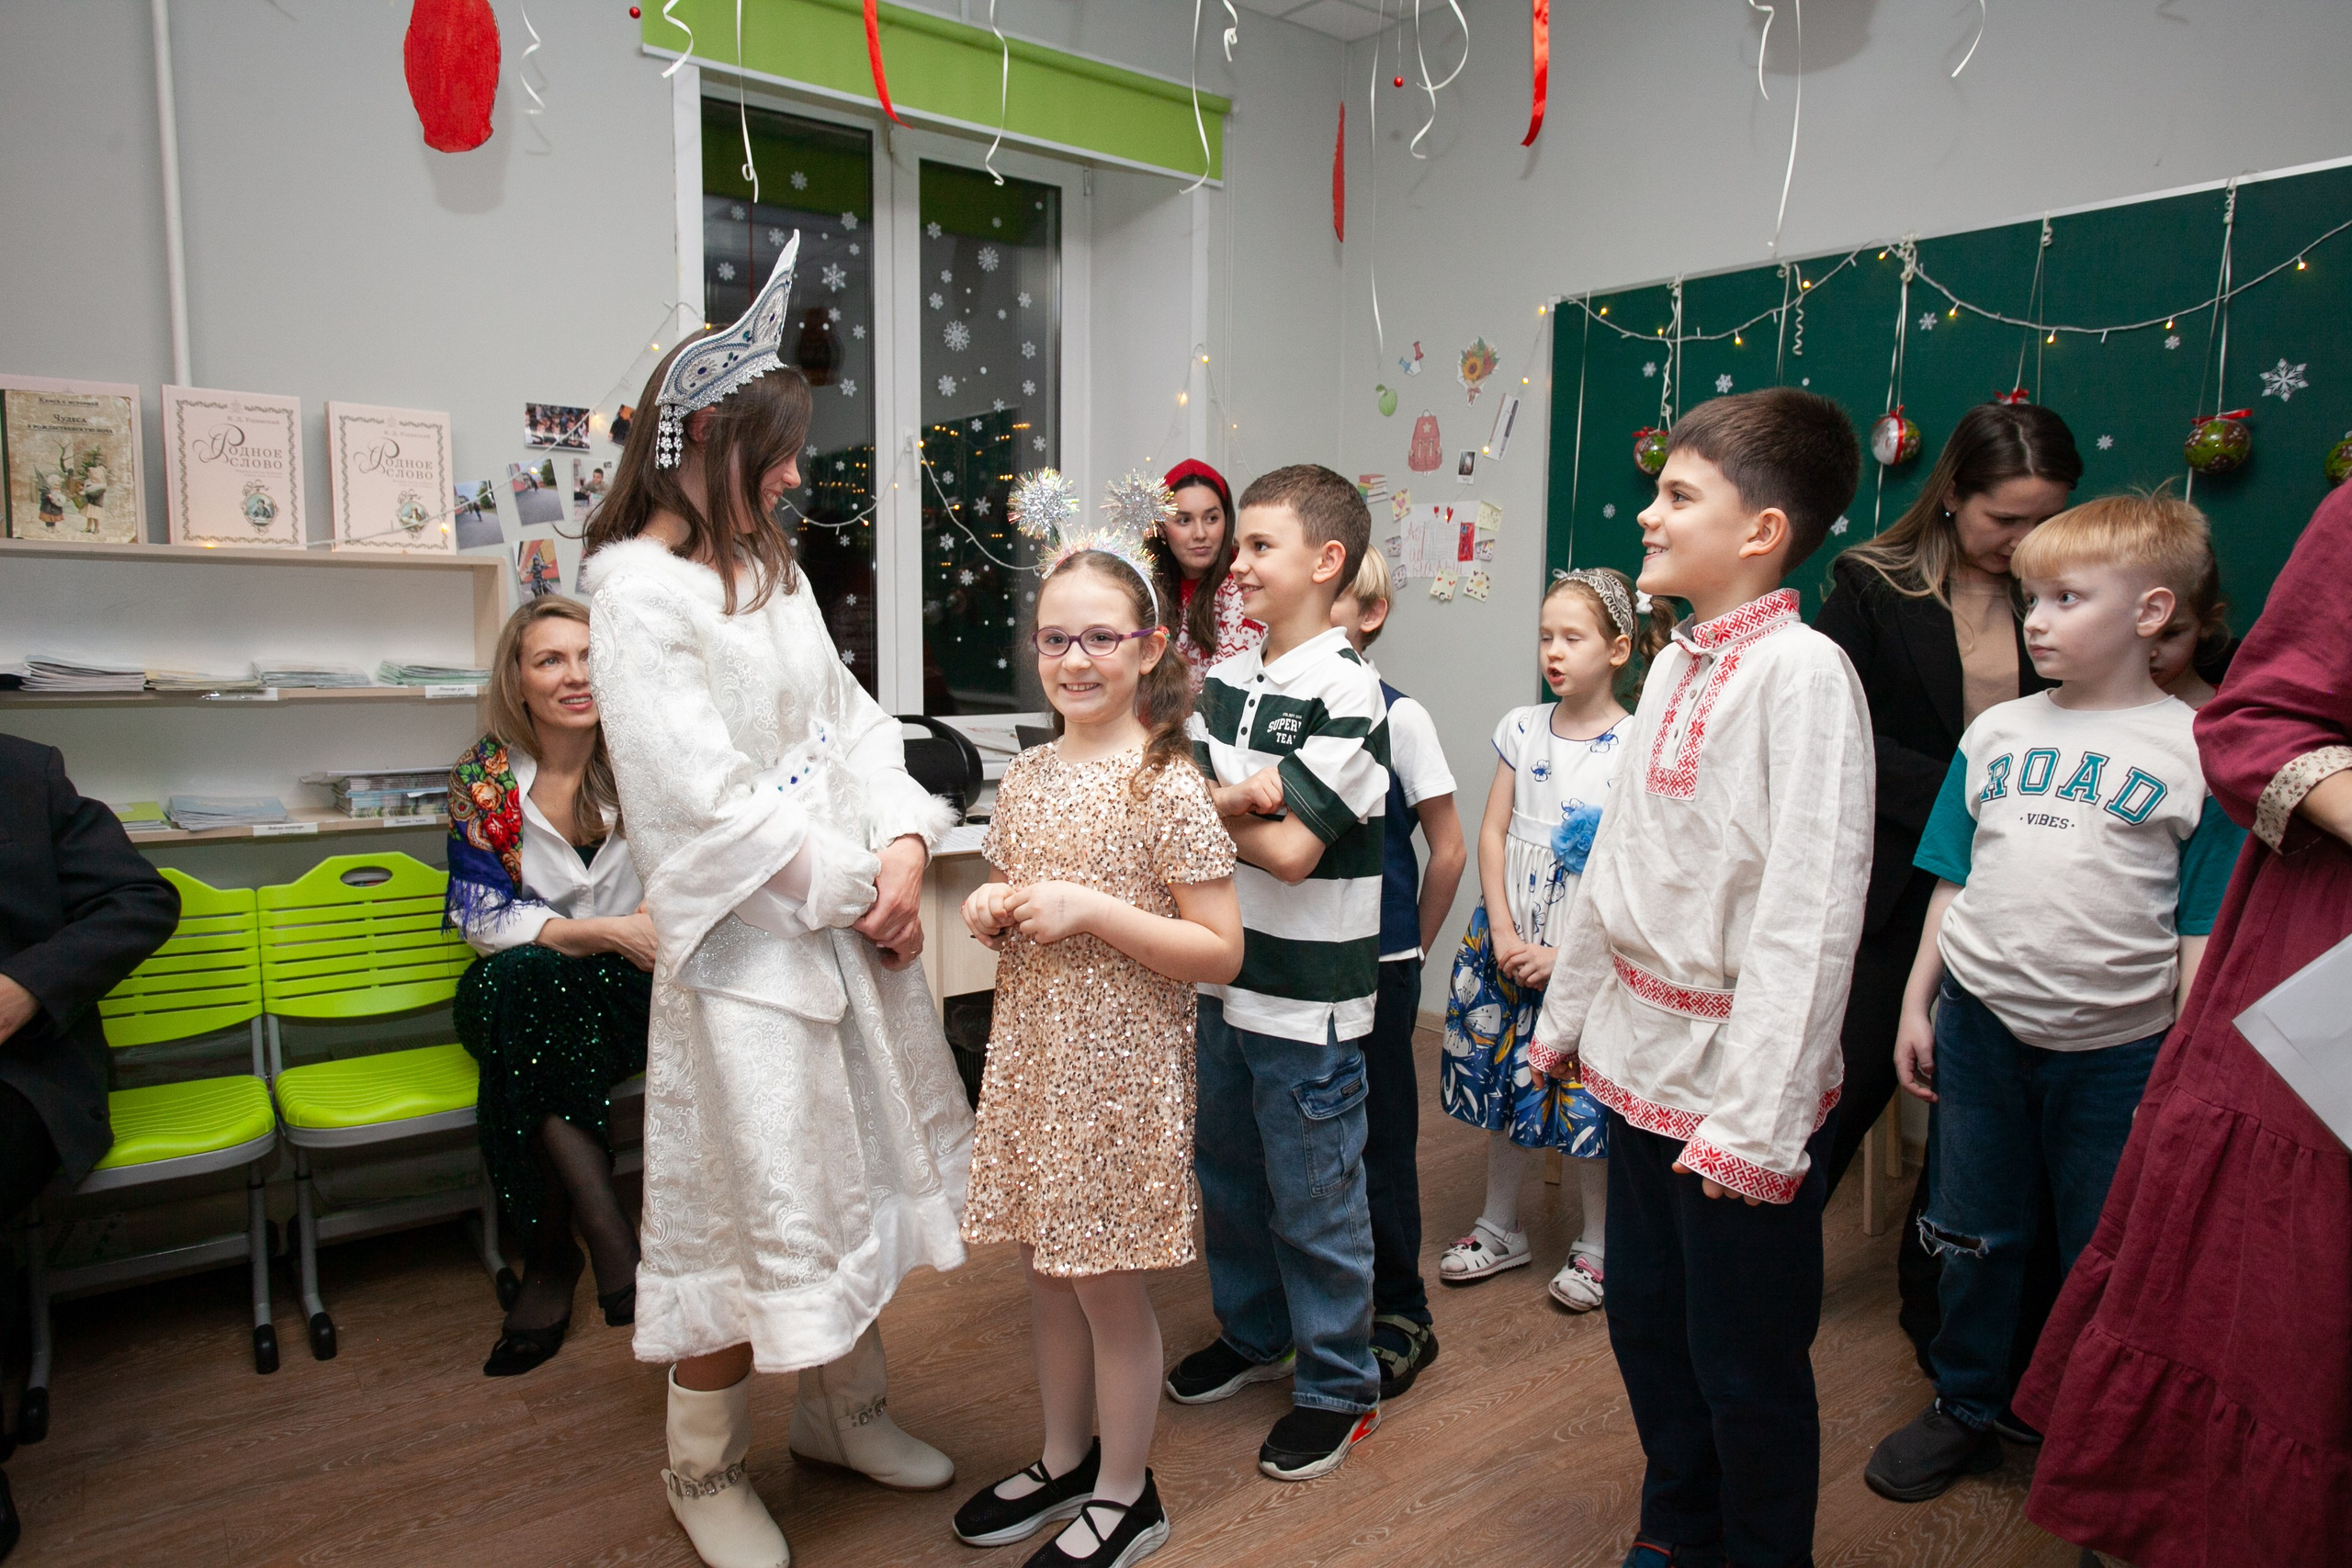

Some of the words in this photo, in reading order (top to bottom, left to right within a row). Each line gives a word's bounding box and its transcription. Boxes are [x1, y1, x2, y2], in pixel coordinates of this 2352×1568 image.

[230, 457, 283, 470] СЛОВО
[386, 468, 434, 479] СЛОВО
[1276, 732, 1296, 745] TEA
[1980, 747, 2168, 826] ROAD
[2027, 812, 2070, 829] VIBES
